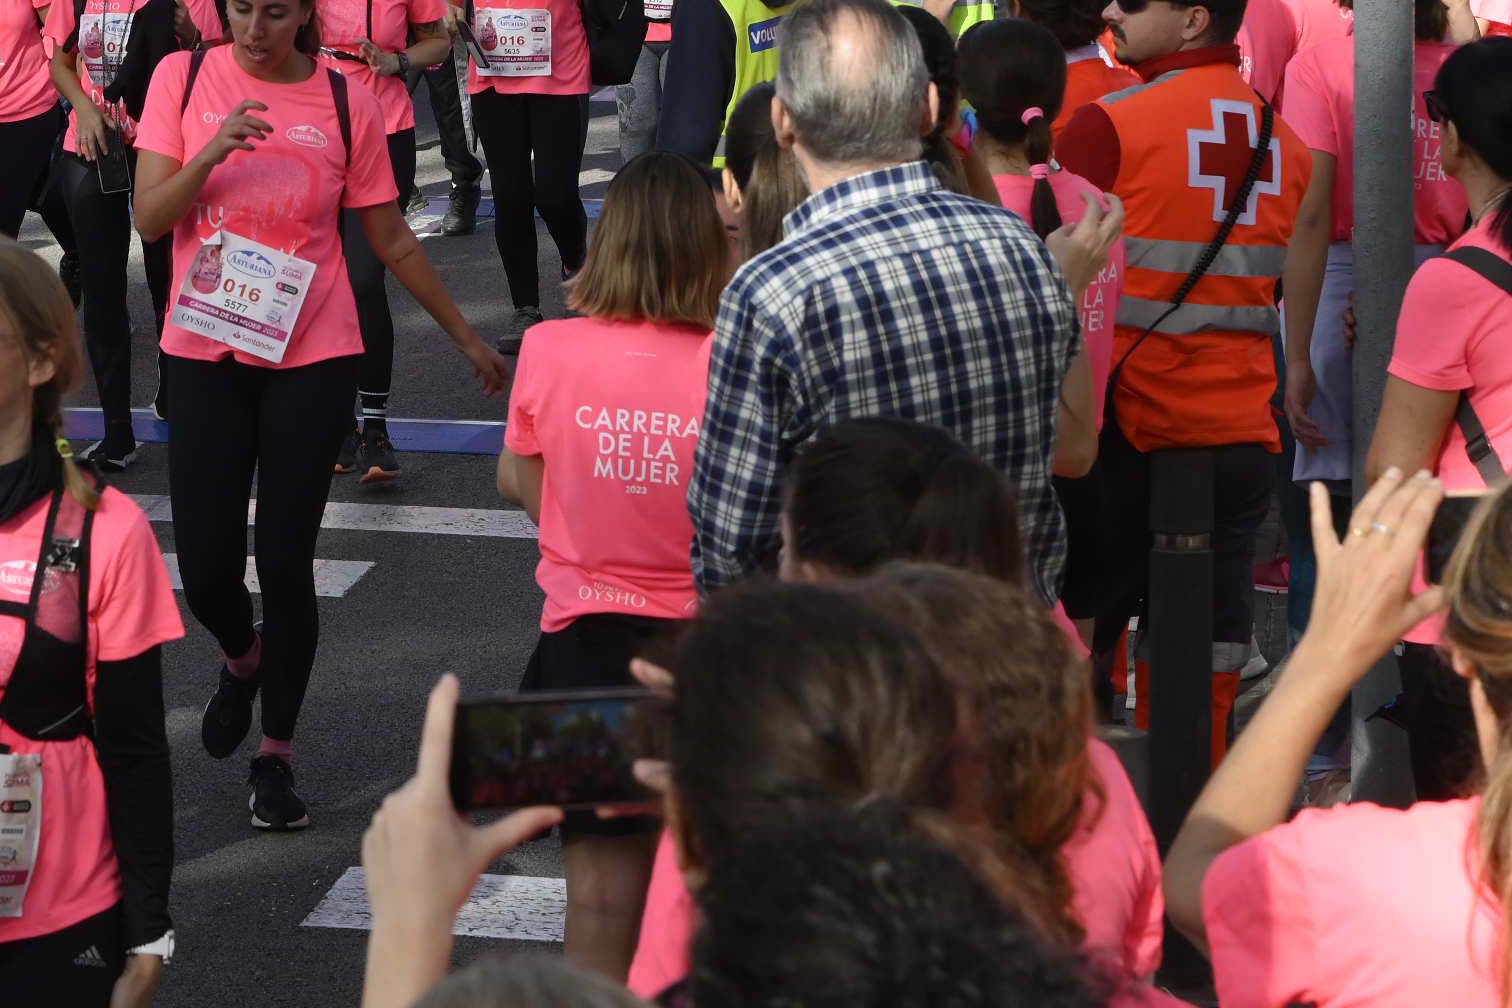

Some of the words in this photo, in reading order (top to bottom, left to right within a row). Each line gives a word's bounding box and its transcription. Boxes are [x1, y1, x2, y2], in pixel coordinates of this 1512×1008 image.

[499, 35, 526, 46] 016
[230, 253, 273, 278] ASTURIANA
[223, 278, 262, 304] 016
[189, 299, 218, 316] CARRERA
[224, 298, 248, 314] 5577
[181, 312, 216, 331] OYSHO
[241, 334, 276, 353] Santander
[575, 405, 700, 438] CARRERA
[599, 432, 632, 457] DE
[642, 436, 677, 461] LA
[594, 456, 679, 486] MUJER
[578, 584, 647, 608] OYSHO
